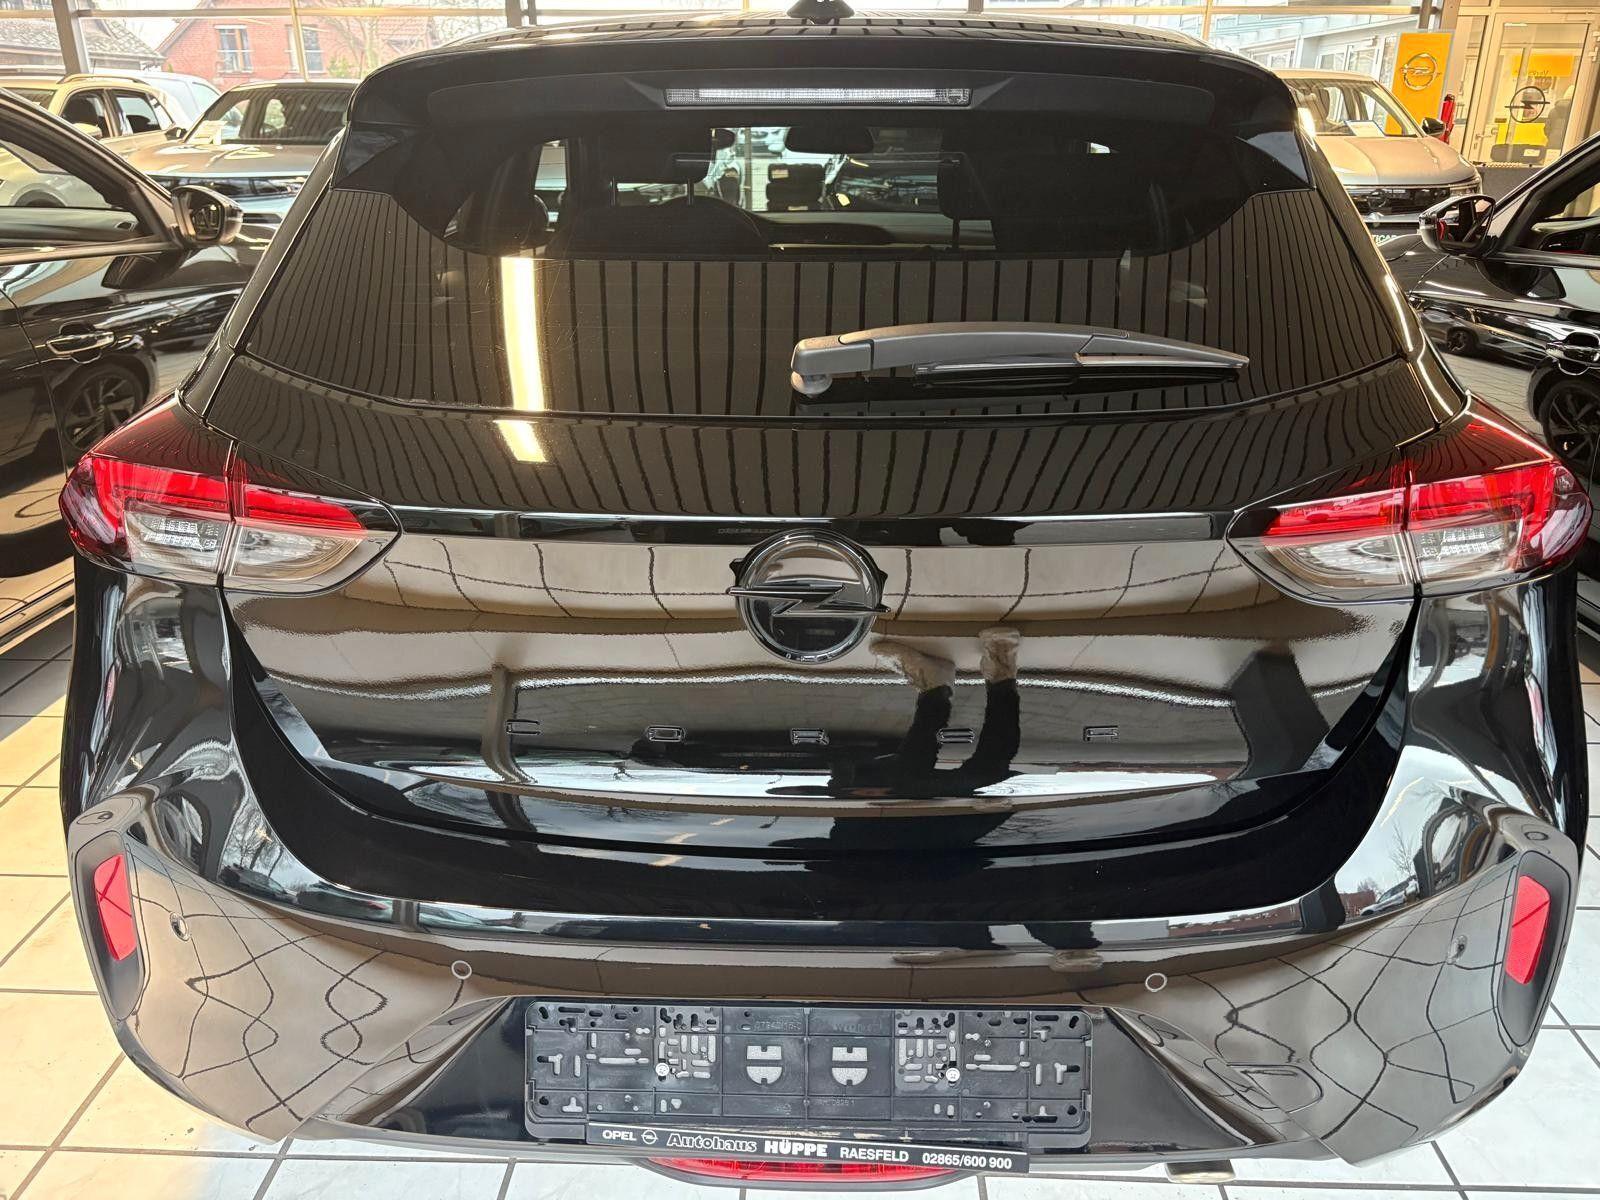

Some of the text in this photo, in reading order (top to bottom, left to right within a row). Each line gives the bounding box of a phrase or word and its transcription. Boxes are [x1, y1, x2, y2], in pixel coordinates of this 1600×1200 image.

[602, 1129, 1012, 1169] OPEL Autohaus HÜPPE RAESFELD 02865/600 900
